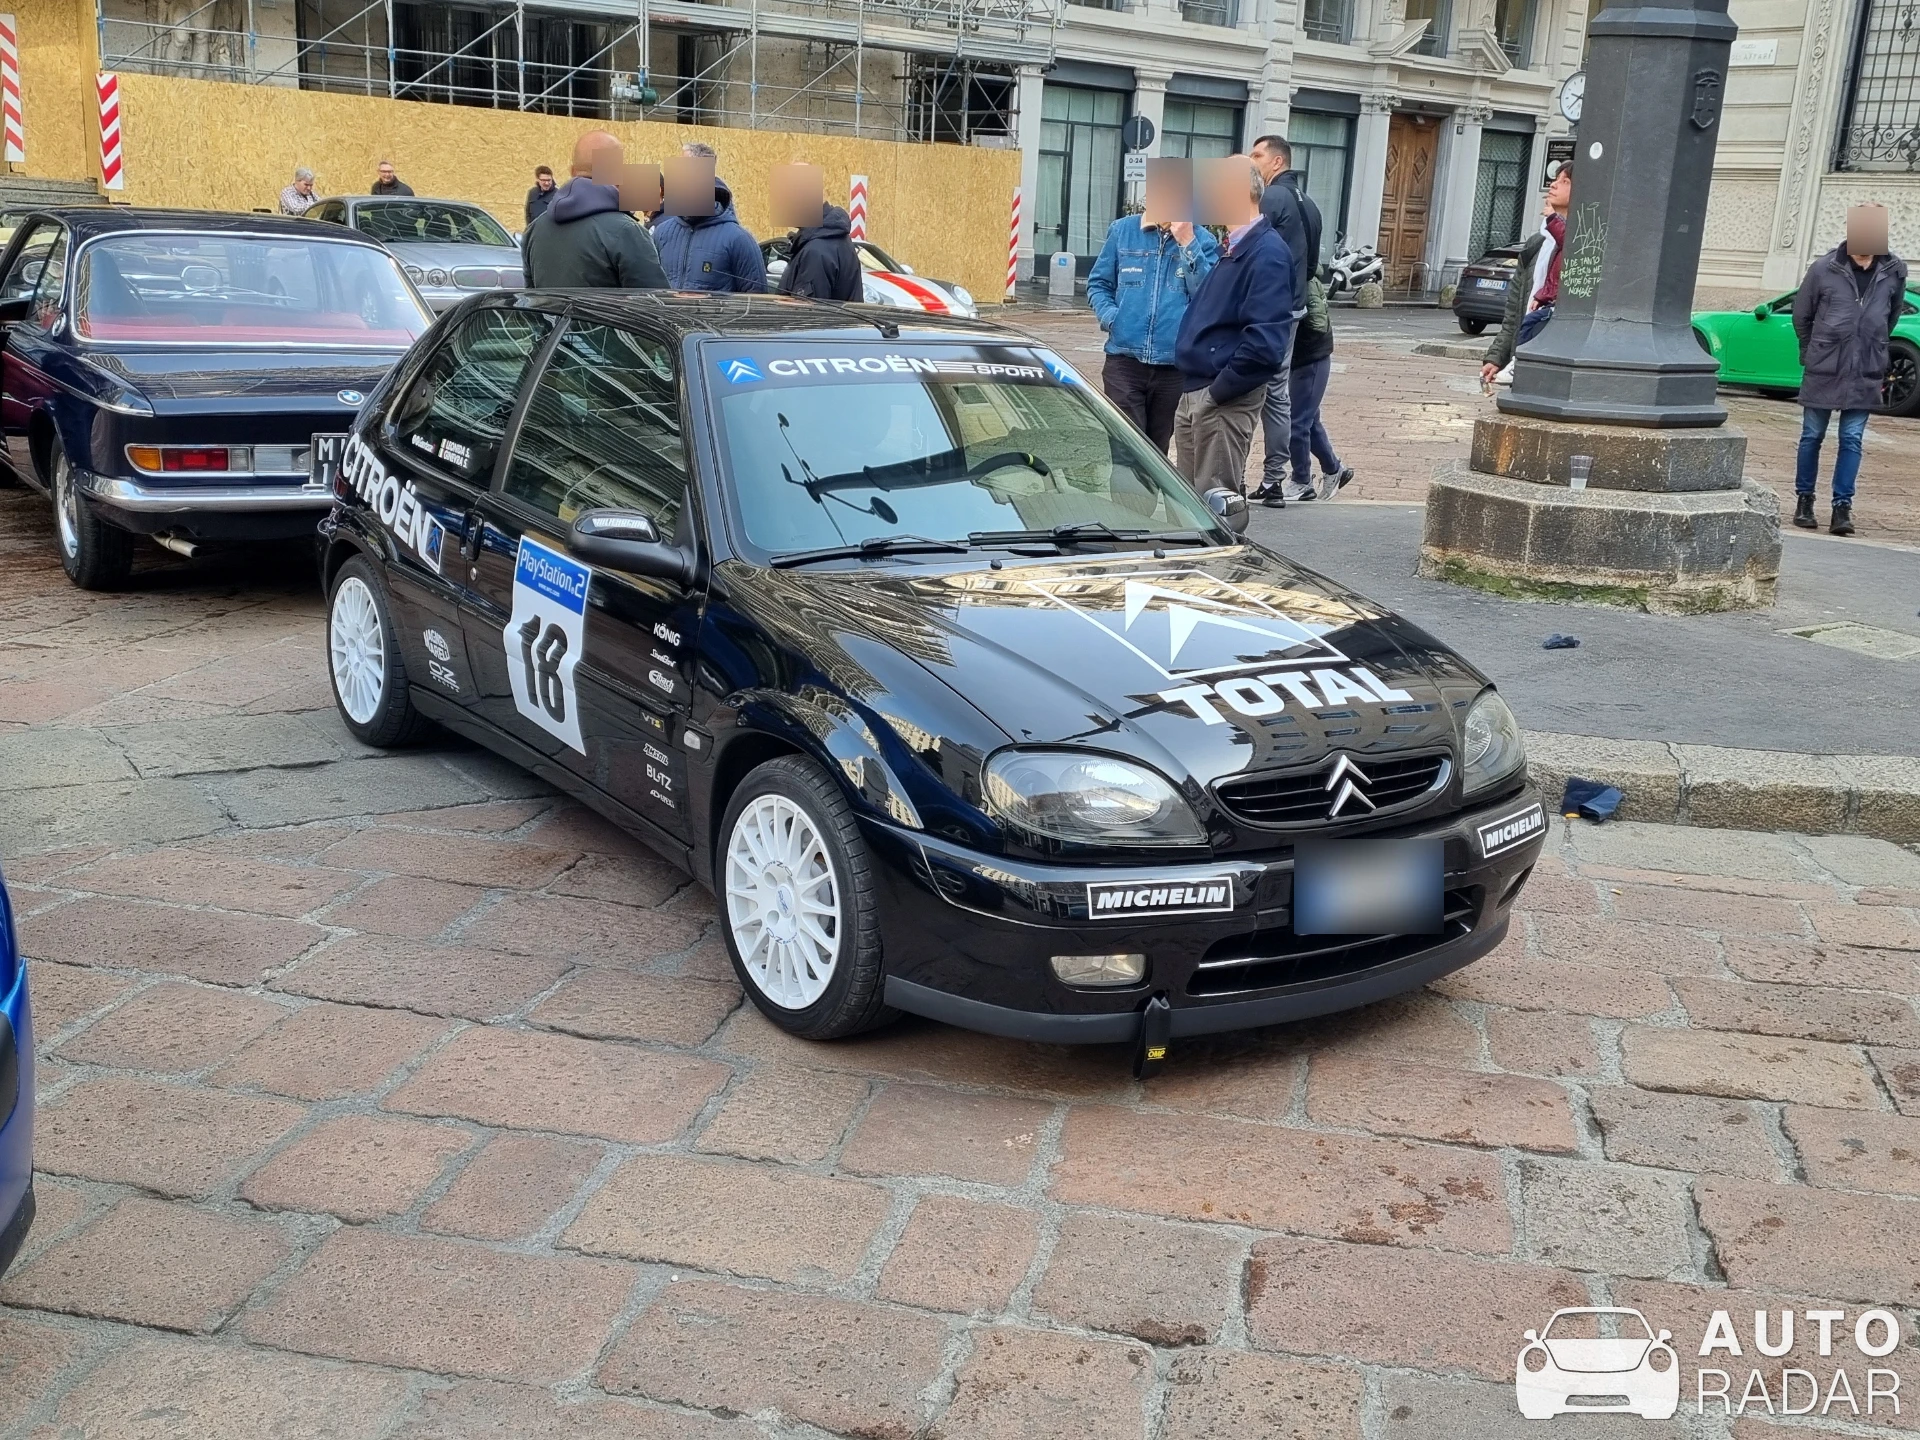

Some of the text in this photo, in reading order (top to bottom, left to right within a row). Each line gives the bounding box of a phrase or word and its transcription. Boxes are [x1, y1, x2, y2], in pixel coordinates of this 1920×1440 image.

[768, 355, 1045, 379] CITROËN SPORT
[342, 432, 428, 558] CITROËN
[520, 548, 585, 598] PlayStation 2
[653, 622, 680, 646] KÖNIG
[517, 614, 568, 724] 18
[1157, 667, 1414, 726] TOTAL
[1486, 811, 1541, 849] MICHELIN
[1096, 887, 1226, 910] MICHELIN
[1147, 1049, 1166, 1058] OMP
